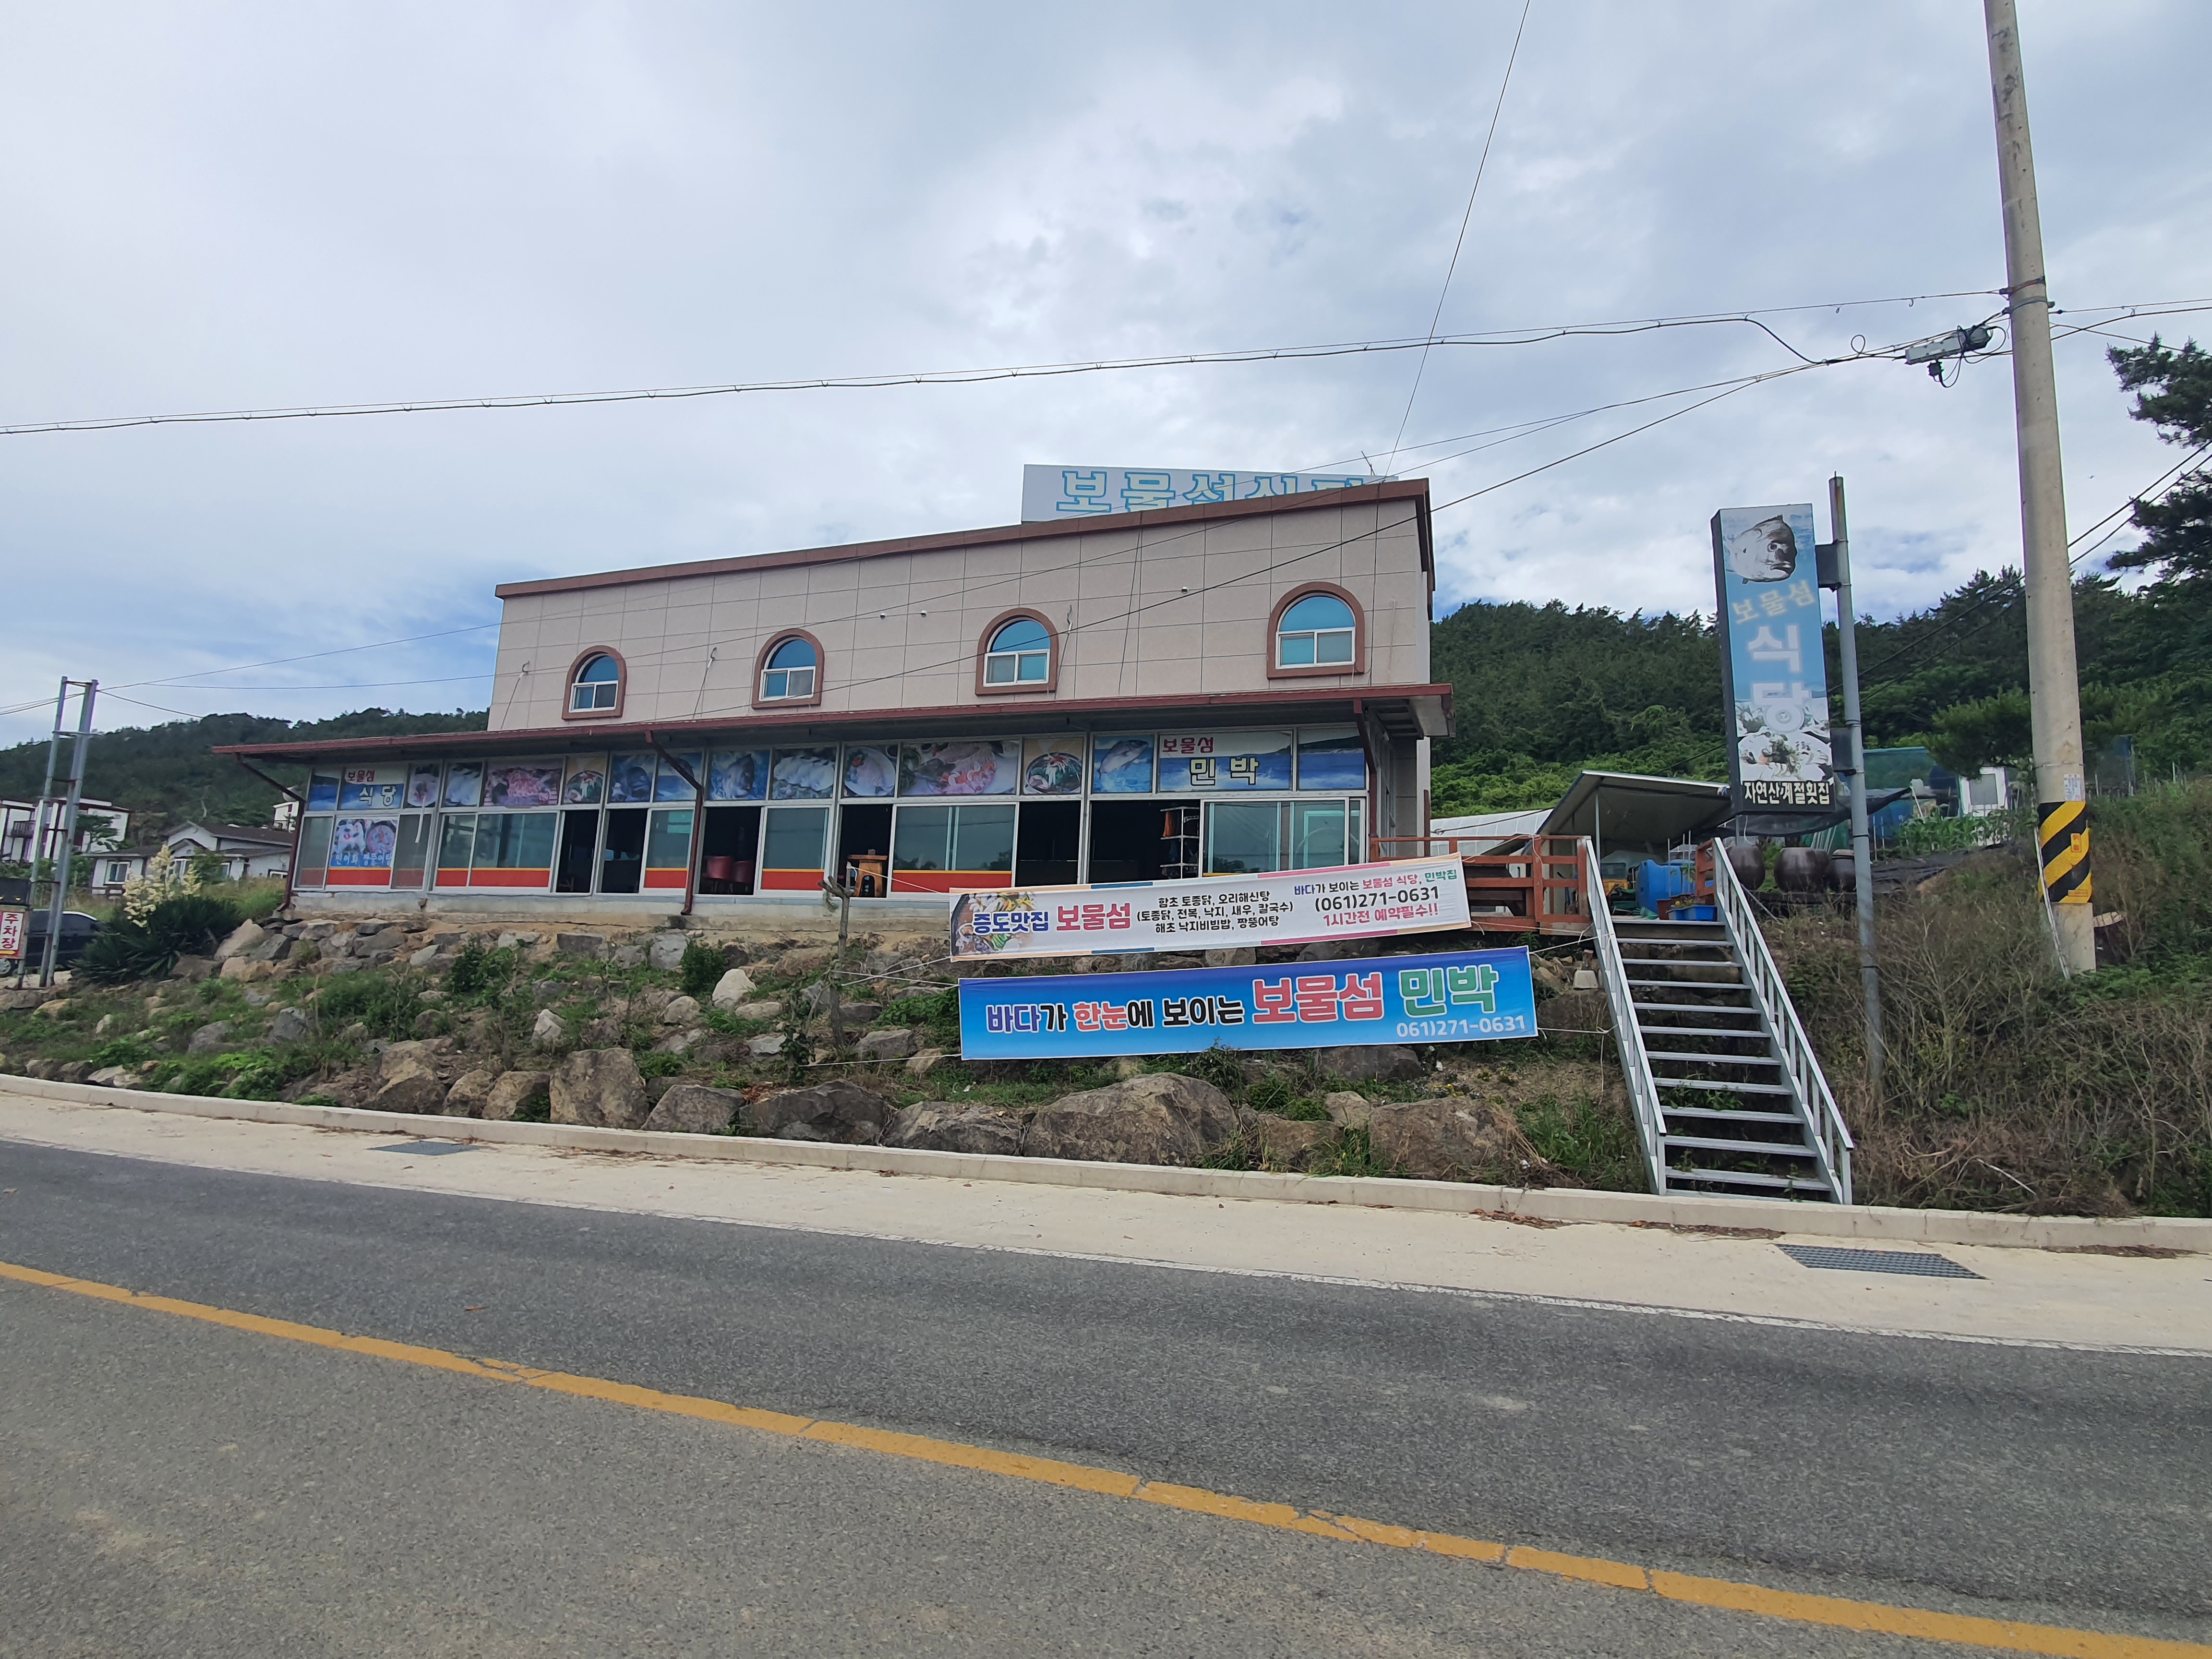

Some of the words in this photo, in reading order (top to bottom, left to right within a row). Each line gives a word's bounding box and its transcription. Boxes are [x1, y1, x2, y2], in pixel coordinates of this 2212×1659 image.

[1732, 580, 1816, 624] 보물섬
[1748, 625, 1812, 733] 식당
[1162, 736, 1214, 754] 보물섬
[348, 770, 375, 782] 보물섬
[1190, 757, 1260, 786] 민박
[360, 786, 397, 806] 식당
[1294, 884, 1325, 895] 바다가
[1329, 881, 1359, 893] 보이는
[1363, 877, 1393, 890] 보물섬
[1396, 874, 1422, 885] 식당,
[1425, 869, 1457, 883] 민박집
[1158, 897, 1178, 908] 함초
[1182, 895, 1215, 907] 토종닭,
[1218, 891, 1270, 904] 오리해신탕
[1315, 886, 1439, 912] (061)271-0631
[973, 912, 1048, 933] 증도맛집
[1057, 903, 1130, 931] 보물섬
[1137, 910, 1174, 922] (토종닭,
[1177, 908, 1201, 919] 전복,
[1204, 907, 1228, 917] 낙지,
[1231, 905, 1255, 916] 새우,
[1258, 902, 1293, 914] 칼국수)
[1155, 923, 1176, 933] 해초
[1178, 919, 1234, 932] 낙지비빔밥,
[1237, 915, 1279, 929] 짱뚱어탕
[1323, 912, 1370, 926] 1시간전
[1375, 902, 1438, 922] 예약필수!!
[1, 914, 19, 949] 주차장
[986, 1004, 1067, 1033] 바다가
[1072, 999, 1154, 1032] 한눈에
[1163, 996, 1244, 1027] 보이는
[1253, 972, 1384, 1024] 보물섬
[1399, 964, 1499, 1017] 민박
[1396, 1015, 1526, 1038] 061)271-0631
